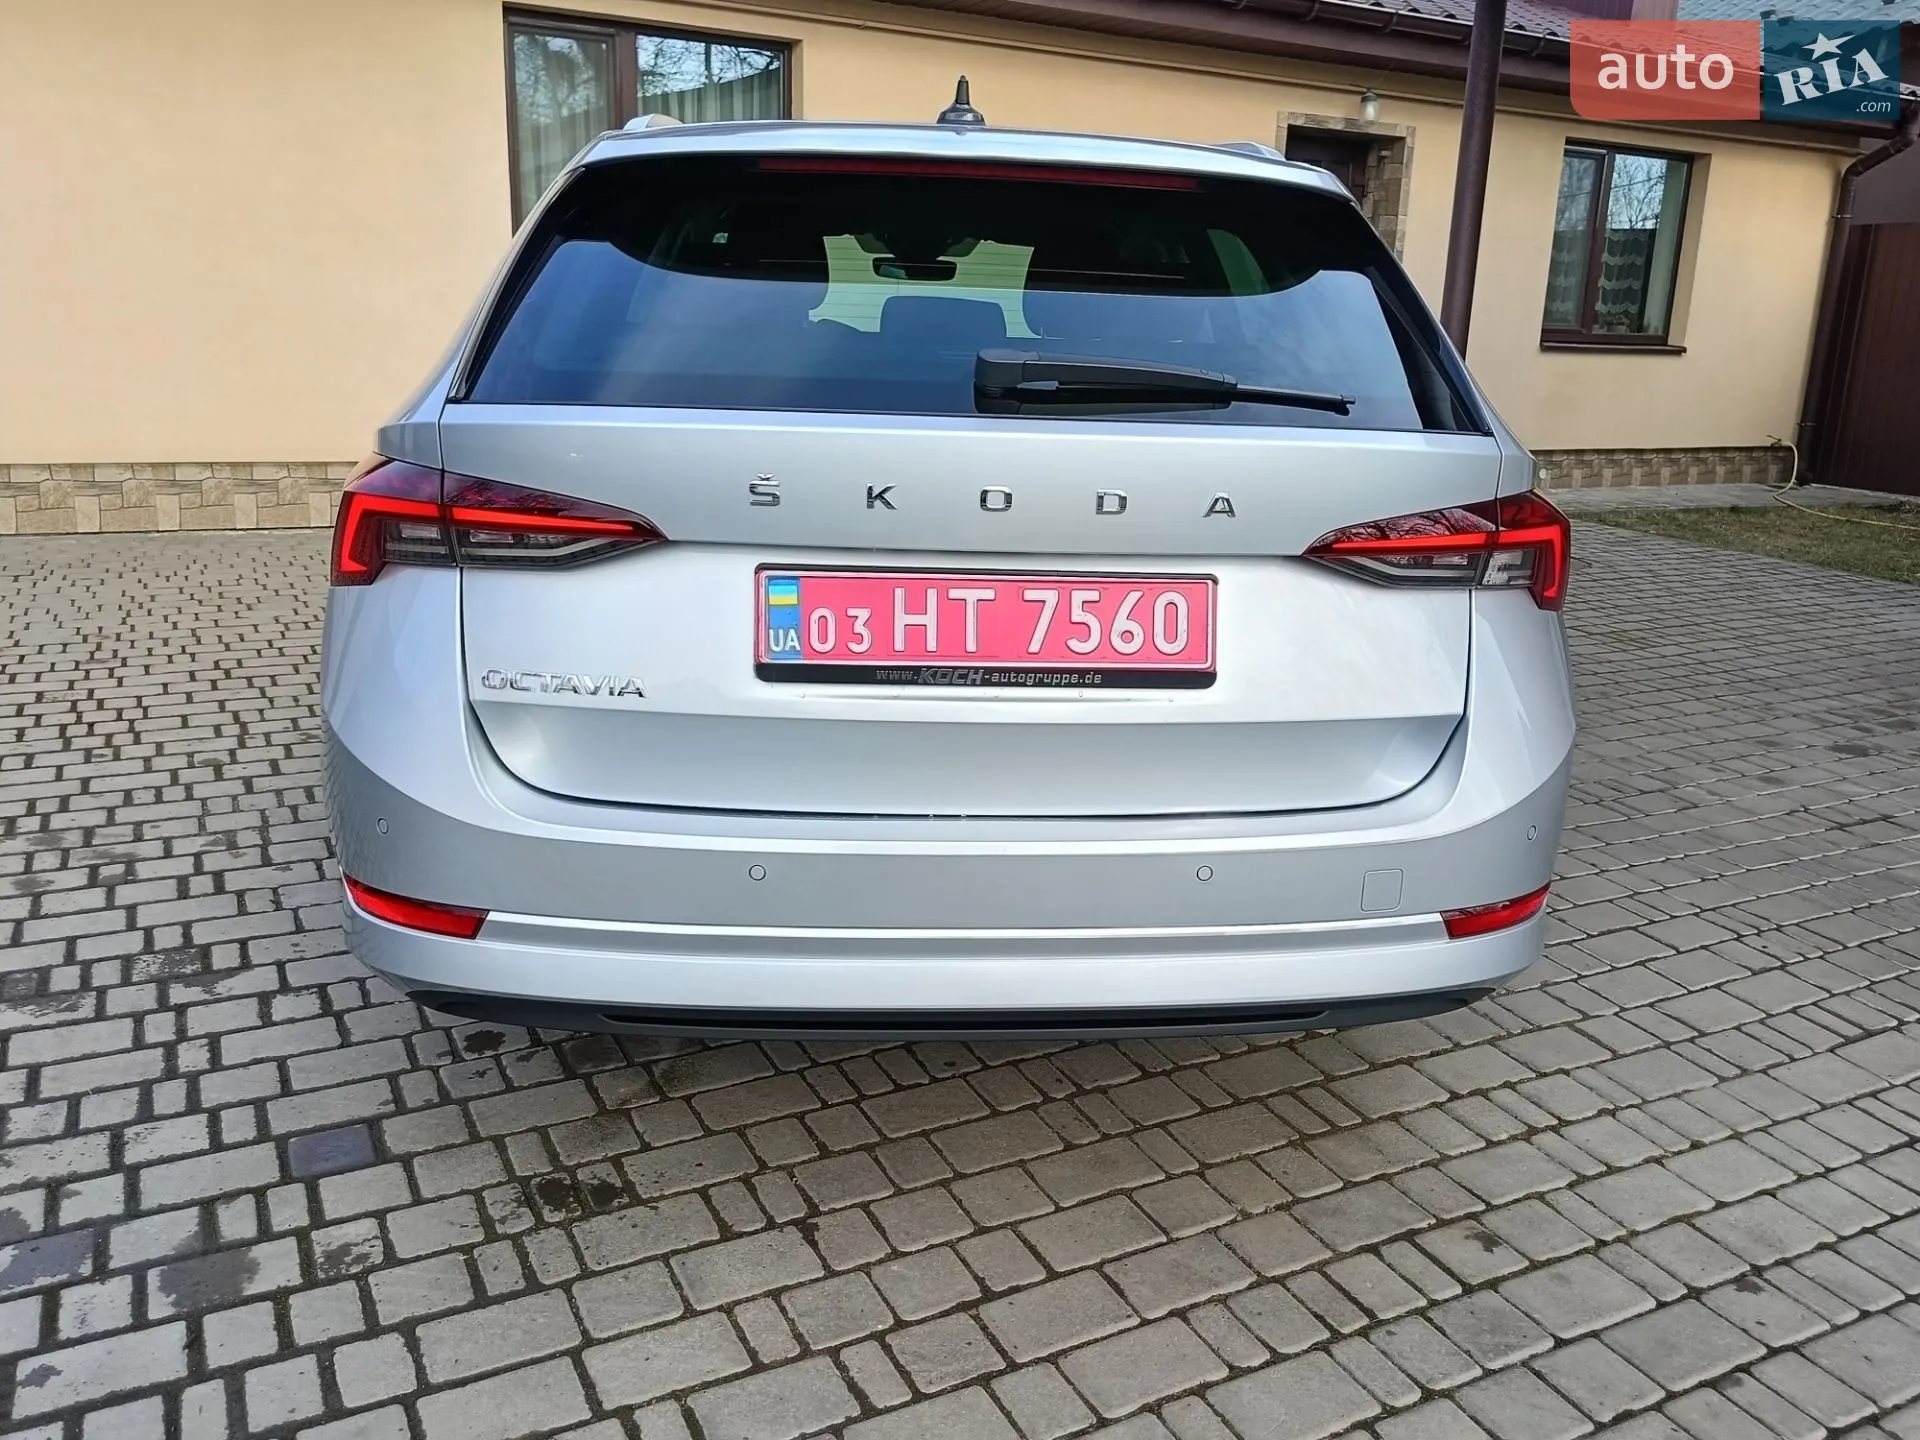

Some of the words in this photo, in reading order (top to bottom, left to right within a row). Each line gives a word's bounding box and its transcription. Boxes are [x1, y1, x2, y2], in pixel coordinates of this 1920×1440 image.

[808, 606, 873, 655] 03
[892, 586, 997, 654] HT
[1021, 588, 1190, 656] 7560
[768, 627, 801, 653] UA
[481, 669, 648, 698] OCTAVIA
